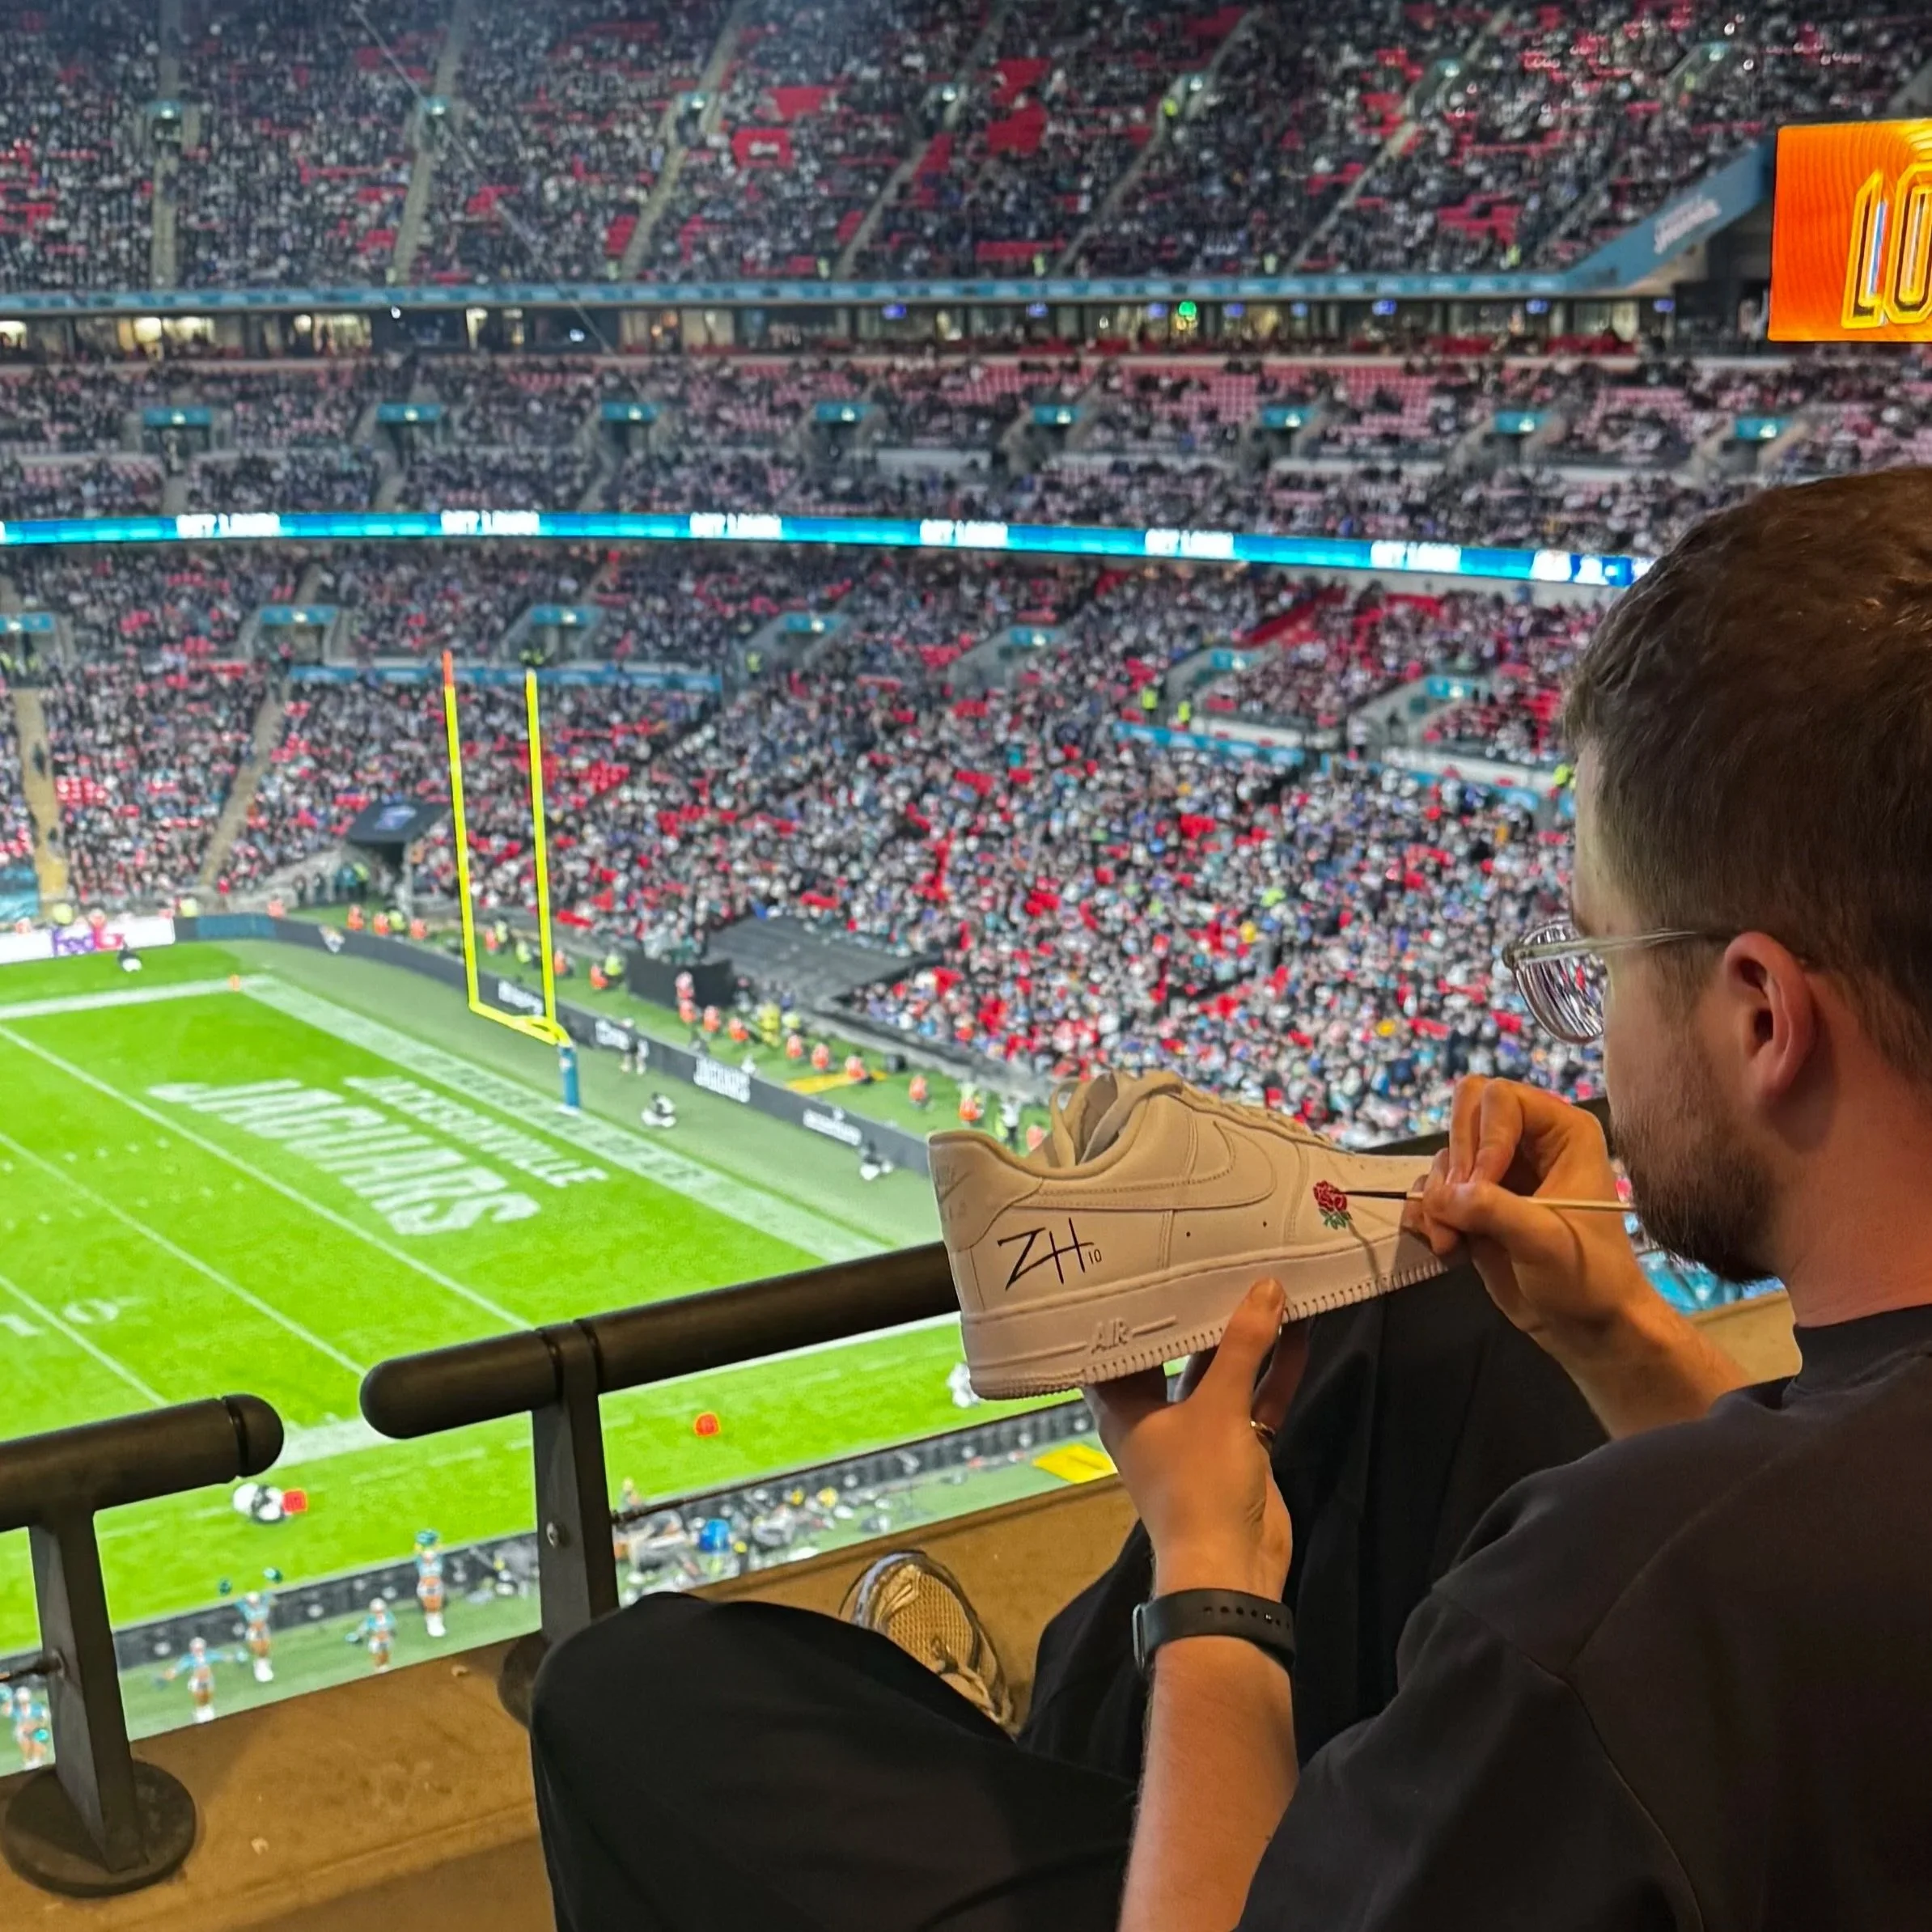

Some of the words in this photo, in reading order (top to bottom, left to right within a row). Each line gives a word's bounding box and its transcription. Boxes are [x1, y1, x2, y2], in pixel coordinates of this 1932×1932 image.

[145, 1078, 540, 1236] JAGUARS
[997, 1216, 1095, 1291] ZH
[1088, 1248, 1103, 1265] 10
[1090, 1316, 1130, 1354] AIR
